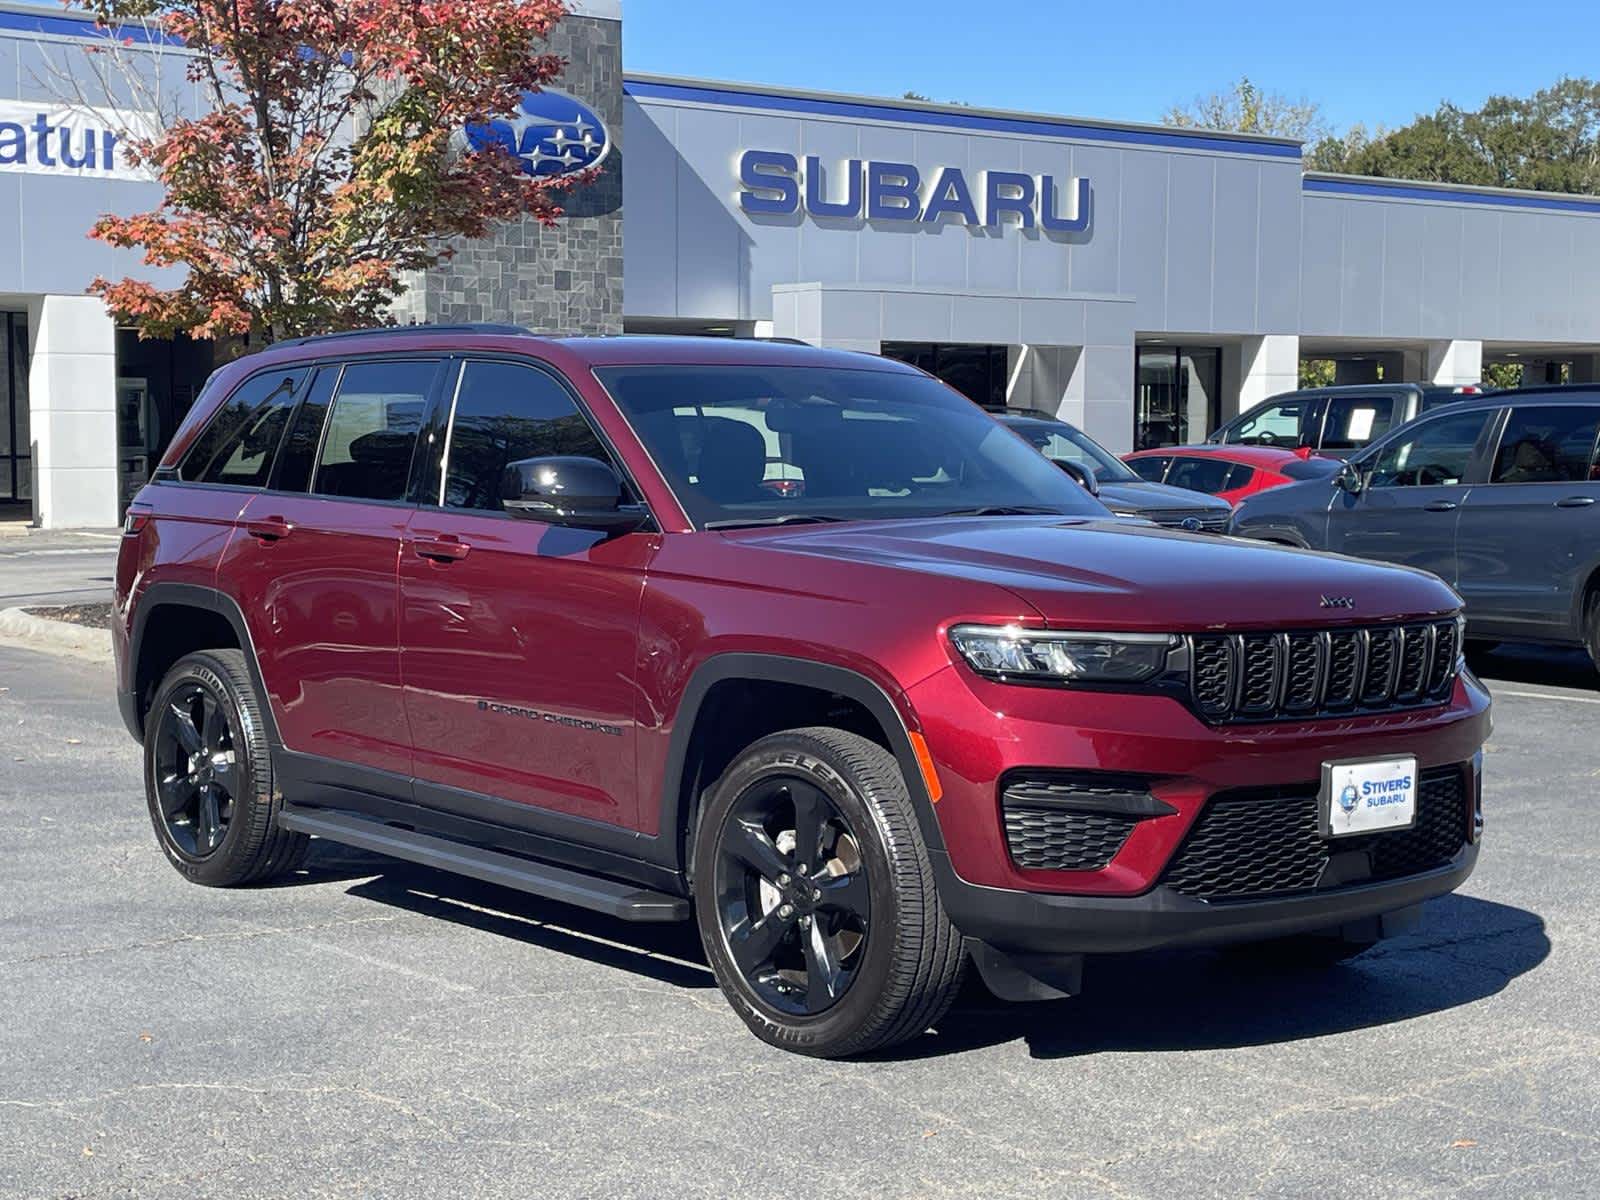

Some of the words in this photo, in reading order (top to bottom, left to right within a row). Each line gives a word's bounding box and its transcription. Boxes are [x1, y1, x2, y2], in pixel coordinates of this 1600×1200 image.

[738, 149, 1092, 233] SUBARU
[1362, 776, 1412, 796] STIVERS
[1366, 793, 1406, 808] SUBARU
